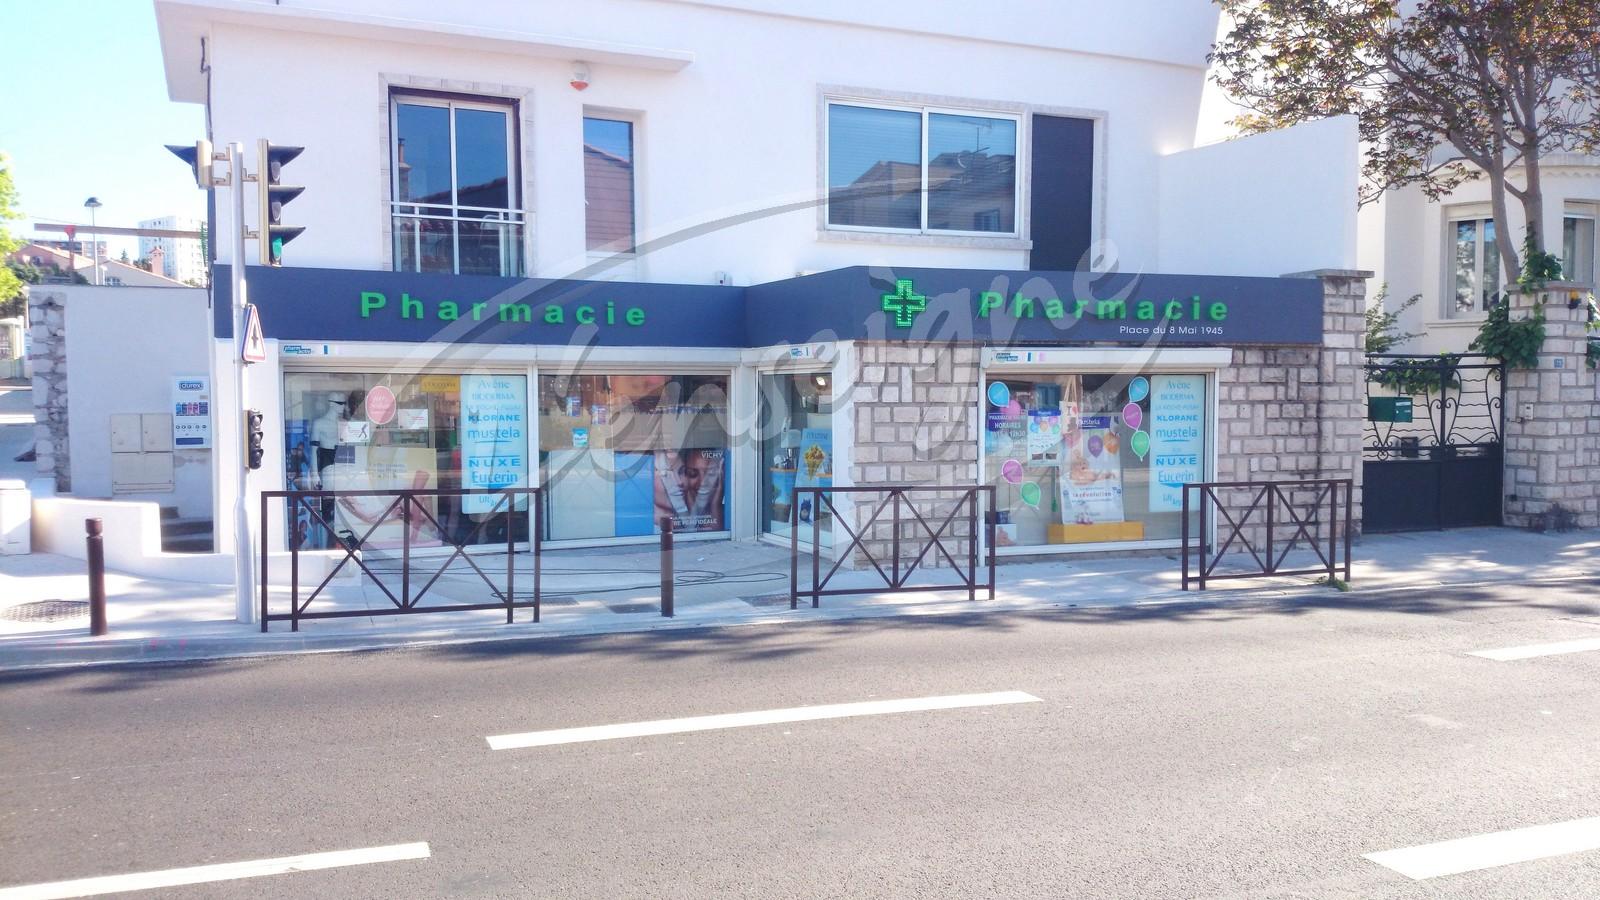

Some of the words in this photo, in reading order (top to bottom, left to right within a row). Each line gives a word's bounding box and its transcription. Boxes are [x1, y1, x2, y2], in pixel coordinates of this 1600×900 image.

[360, 291, 648, 327] Pharmacie
[979, 291, 1229, 321] Pharmacie
[1119, 326, 1149, 334] Place
[1153, 326, 1166, 334] du
[1169, 326, 1175, 334] 8
[1178, 326, 1197, 334] Mai
[1201, 326, 1223, 335] 1945
[468, 426, 520, 439] mustela
[1156, 426, 1198, 437] mustela
[468, 459, 520, 467] NUXE
[472, 471, 517, 483] Eucerin
[1158, 471, 1194, 481] Eucerin
